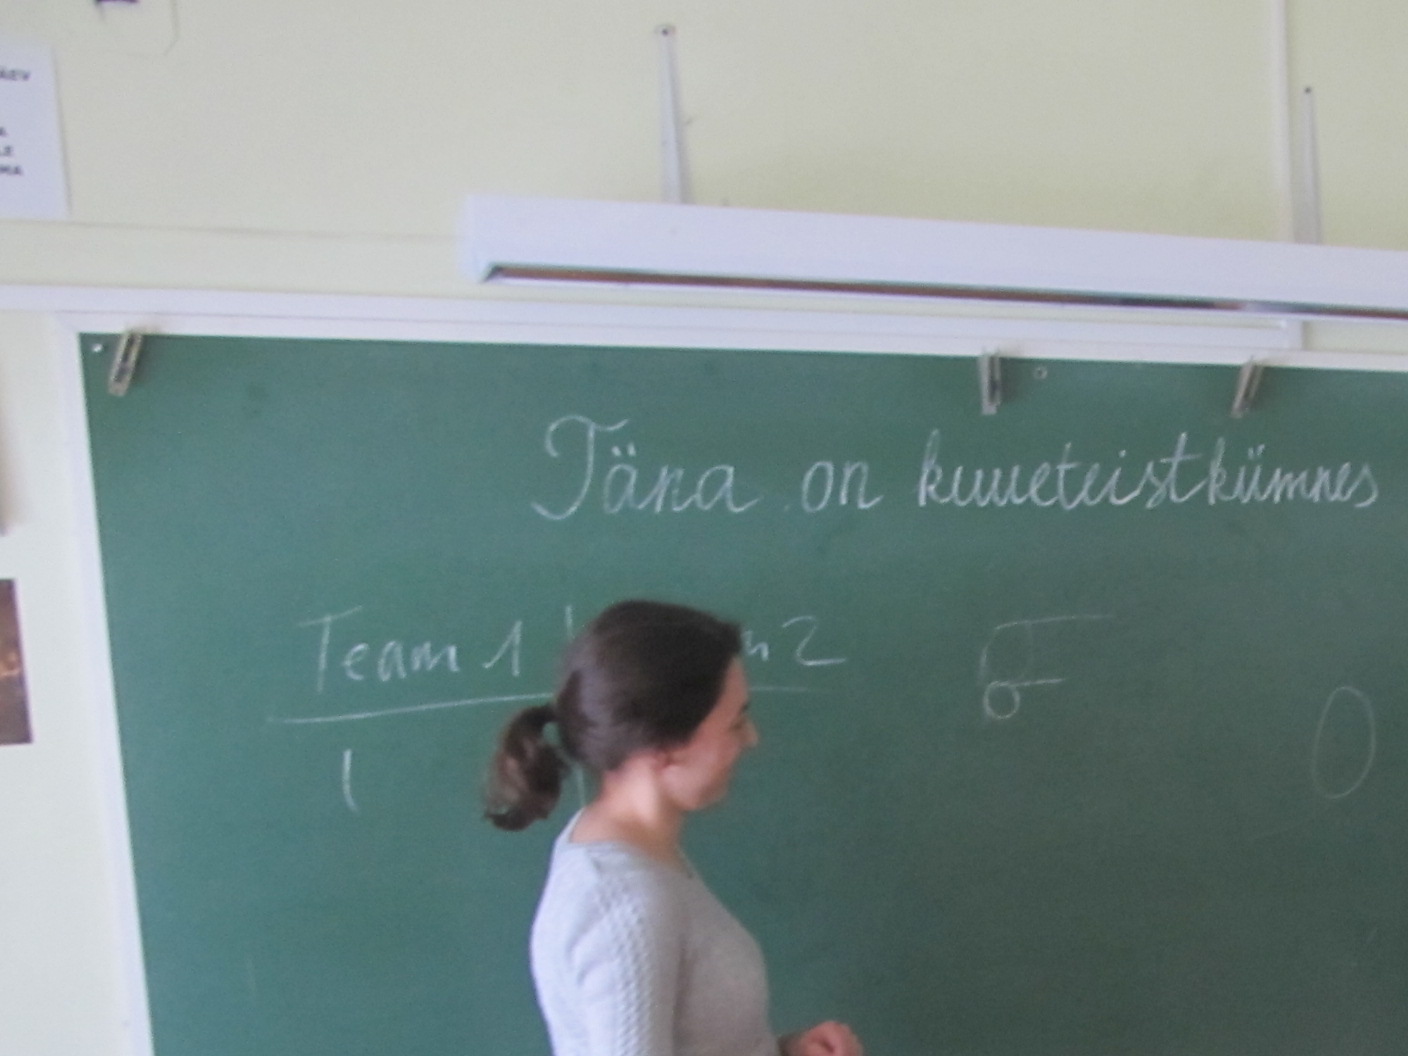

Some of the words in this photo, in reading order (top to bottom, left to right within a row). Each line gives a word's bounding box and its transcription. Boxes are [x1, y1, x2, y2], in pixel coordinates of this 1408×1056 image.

[530, 414, 759, 521] Täna
[800, 460, 884, 514] on
[299, 605, 460, 694] Team
[483, 619, 524, 677] 1
[781, 615, 847, 667] 2
